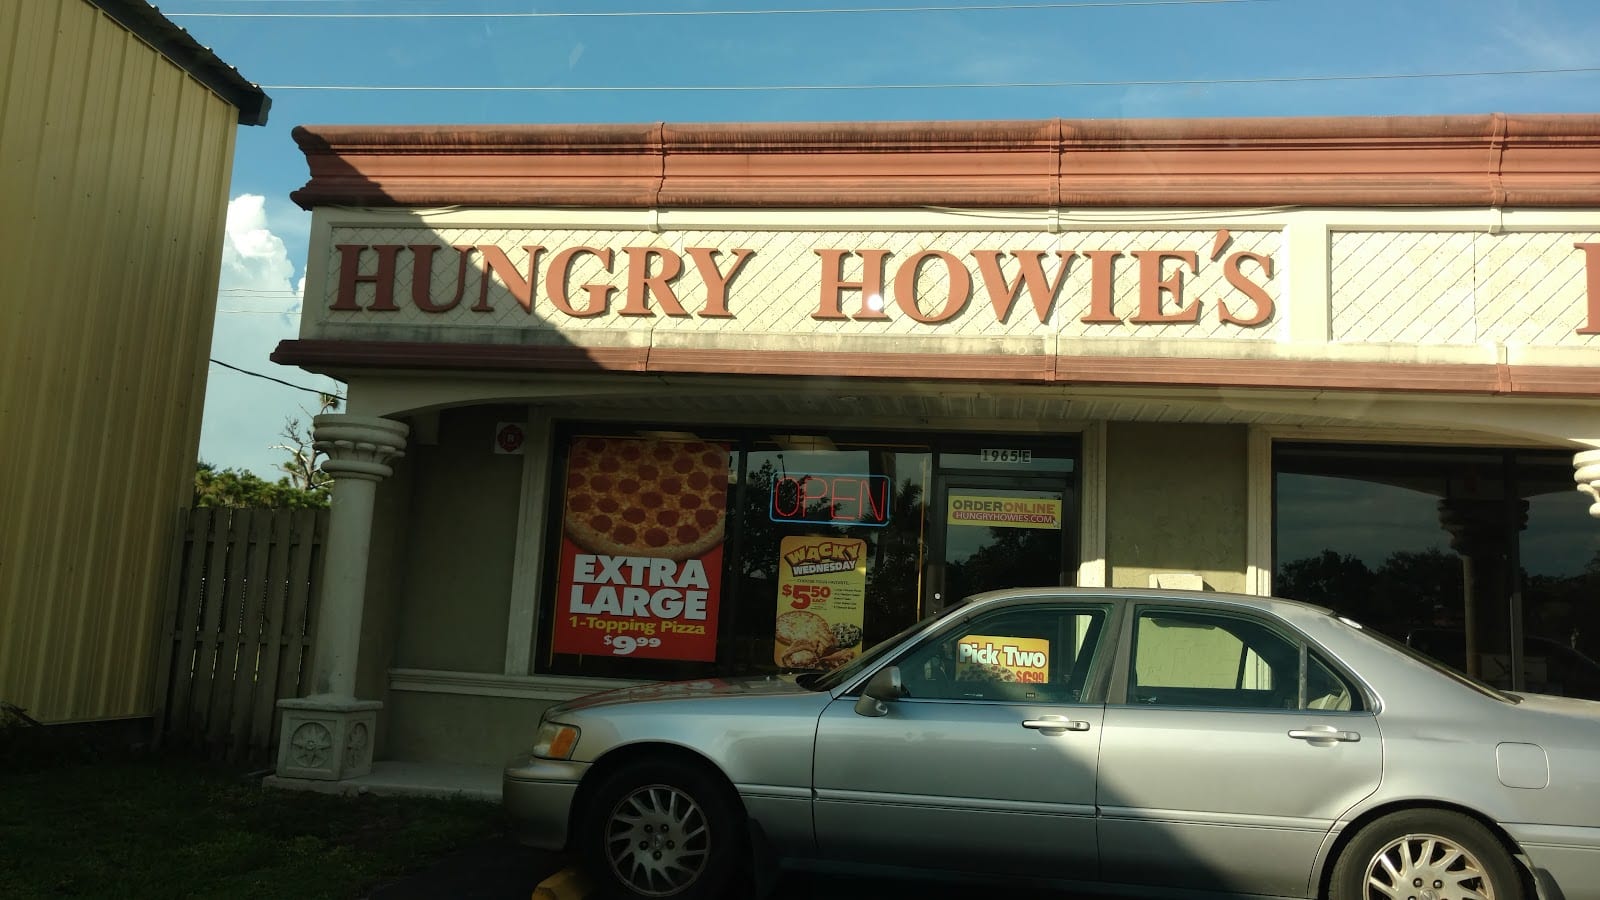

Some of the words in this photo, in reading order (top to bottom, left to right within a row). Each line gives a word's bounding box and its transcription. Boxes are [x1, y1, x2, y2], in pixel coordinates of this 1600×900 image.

[329, 244, 756, 319] HUNGRY
[811, 229, 1276, 327] HOWIE'S
[775, 476, 886, 521] OPEN
[955, 511, 1053, 523] HUNGRYHOWIES.COM
[785, 542, 861, 565] WACKY
[573, 554, 709, 588] EXTRA
[792, 560, 857, 577] WEDNESDAY
[569, 584, 708, 620] LARGE
[569, 615, 656, 635] 1-Topping
[661, 621, 706, 635] Pizza
[959, 643, 1000, 665] Pick
[1003, 645, 1046, 668] Two
